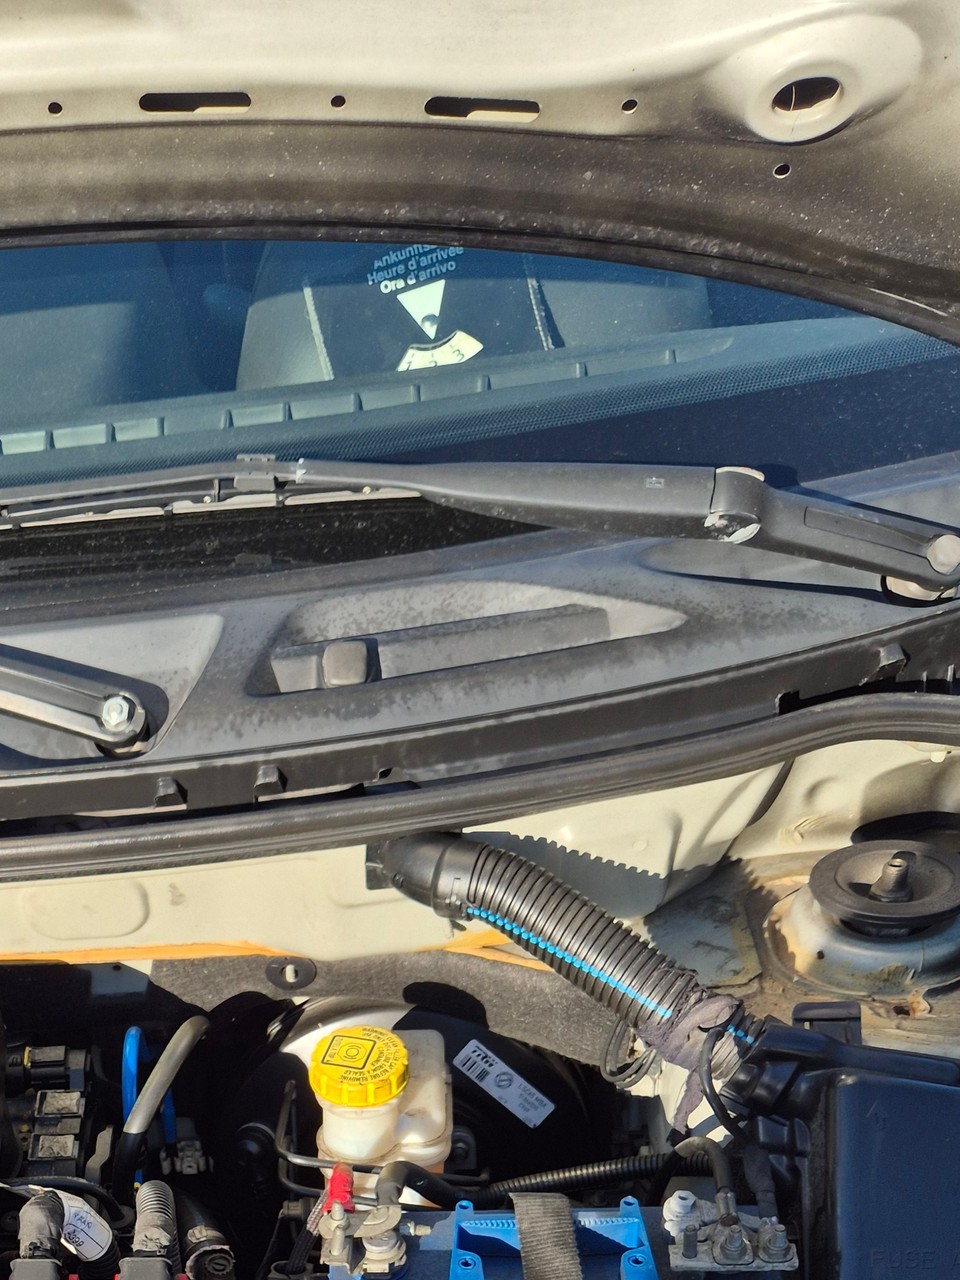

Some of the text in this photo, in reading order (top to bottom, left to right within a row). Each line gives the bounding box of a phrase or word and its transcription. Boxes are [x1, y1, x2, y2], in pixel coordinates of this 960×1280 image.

[367, 264, 405, 286] Heure
[380, 260, 456, 295] Ora d'arrivo
[471, 1046, 497, 1068] TRW
[870, 1248, 937, 1270] FUSE
